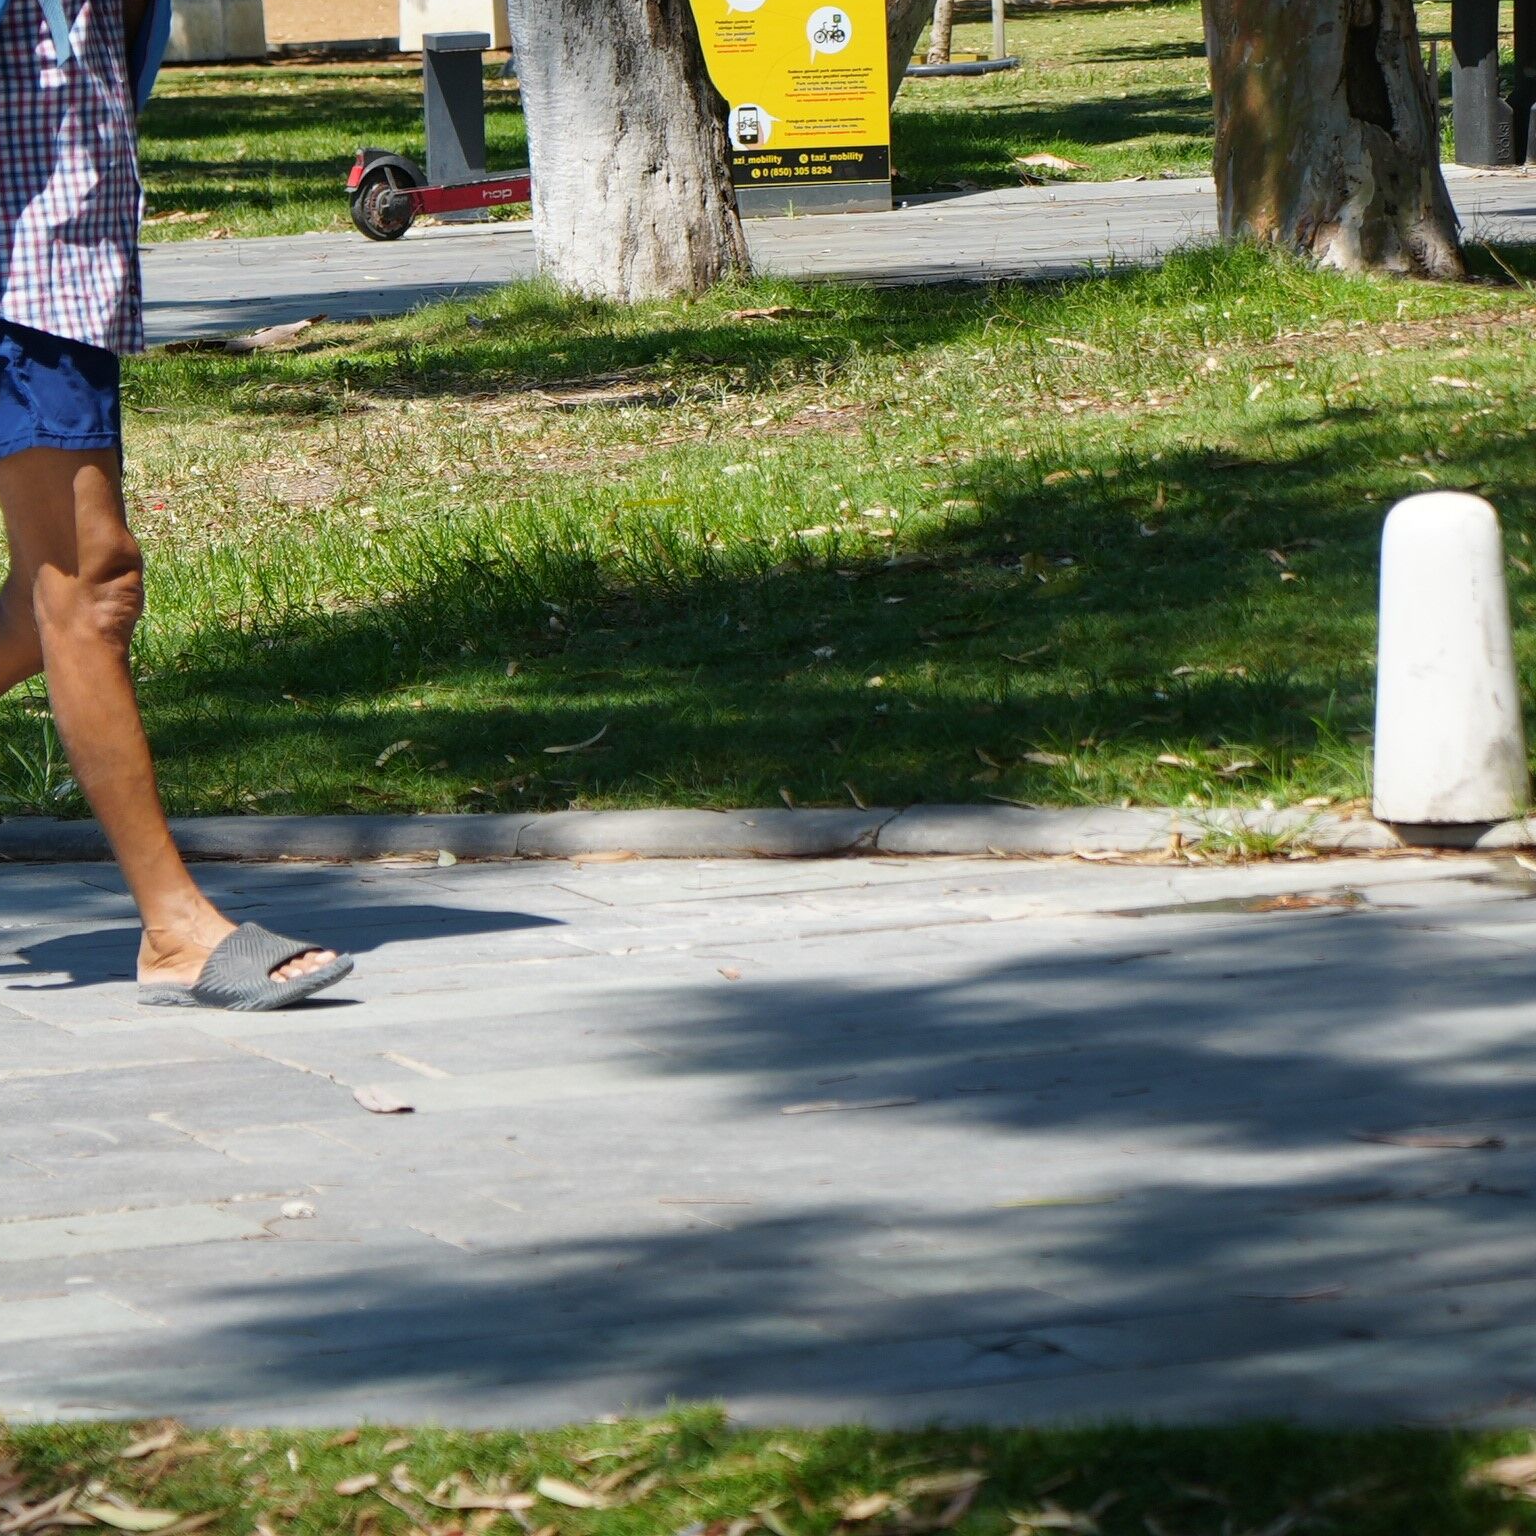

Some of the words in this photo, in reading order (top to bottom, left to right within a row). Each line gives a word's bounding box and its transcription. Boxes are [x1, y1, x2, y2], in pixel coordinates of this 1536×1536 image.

[733, 155, 782, 166] azi_mobility
[811, 152, 863, 163] tazi_mobility
[762, 168, 769, 177] 0
[770, 167, 792, 178] (850)
[793, 167, 810, 175] 305
[811, 166, 832, 174] 8294
[482, 188, 512, 200] hop
